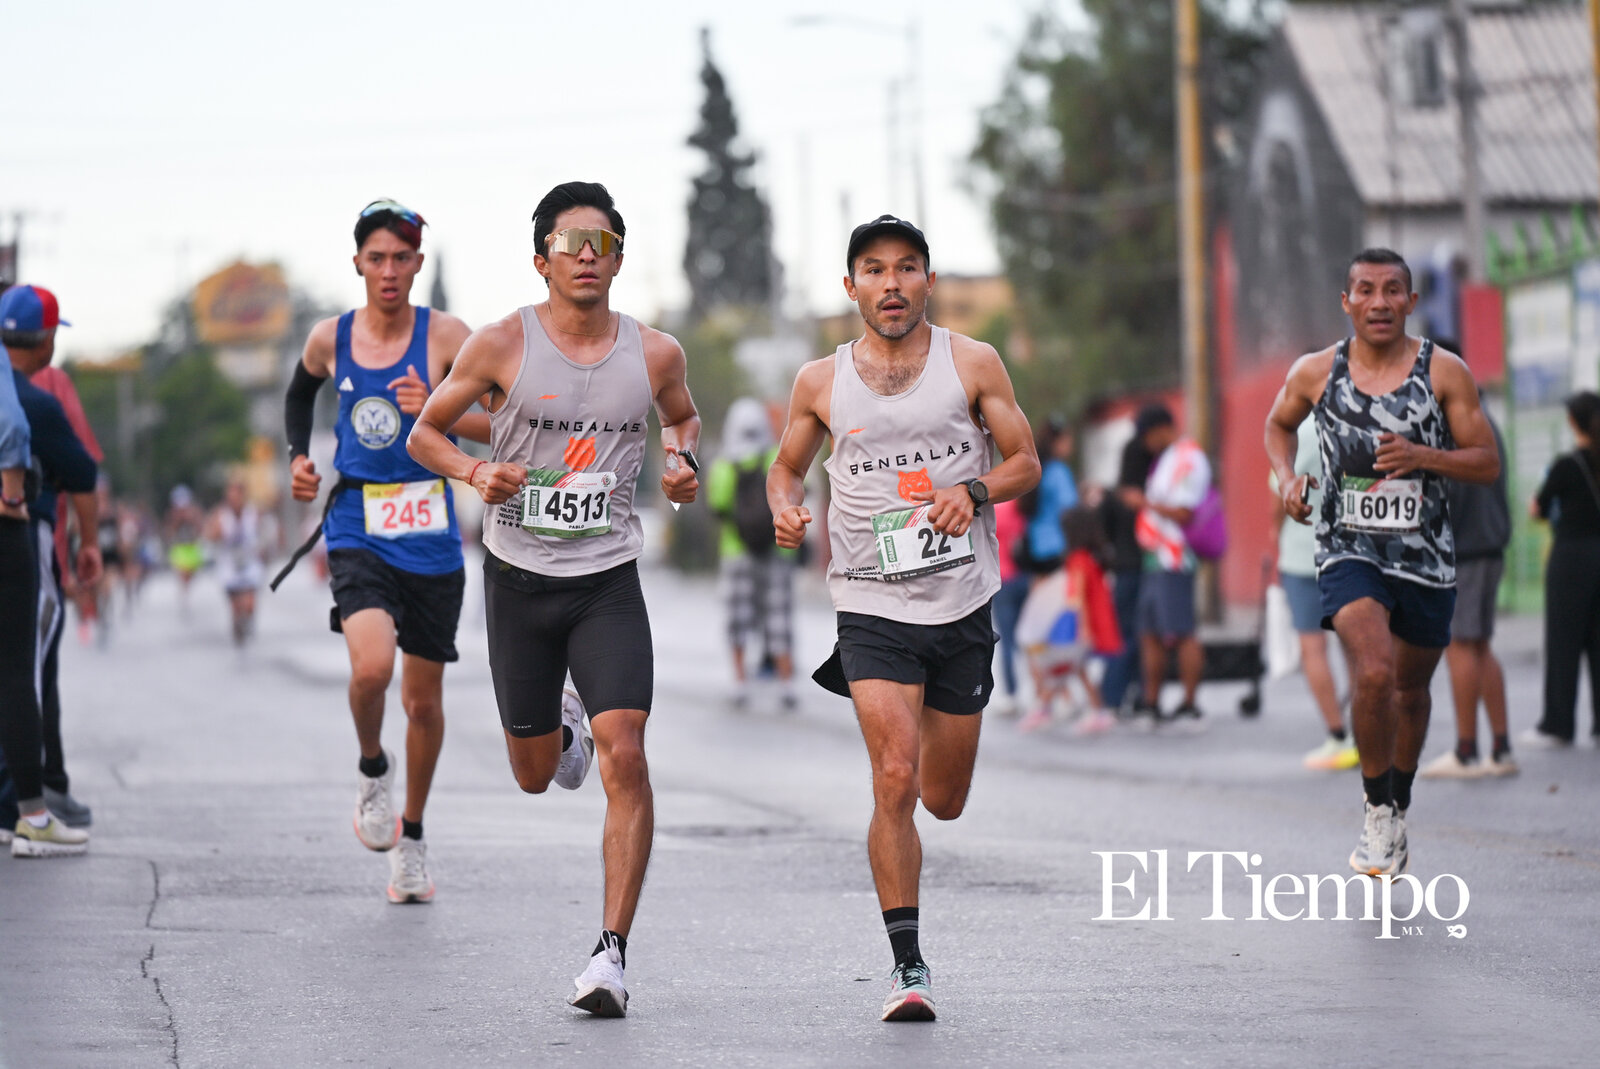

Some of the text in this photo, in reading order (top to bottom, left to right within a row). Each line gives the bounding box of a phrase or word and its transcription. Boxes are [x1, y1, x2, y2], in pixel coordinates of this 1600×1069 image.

[529, 419, 640, 433] BENGALAS
[850, 441, 971, 475] BENGALAS
[382, 499, 431, 529] 245
[545, 490, 606, 523] 4513
[1360, 495, 1416, 521] 6019
[917, 527, 952, 560] 22
[929, 556, 947, 565] DANIEL
